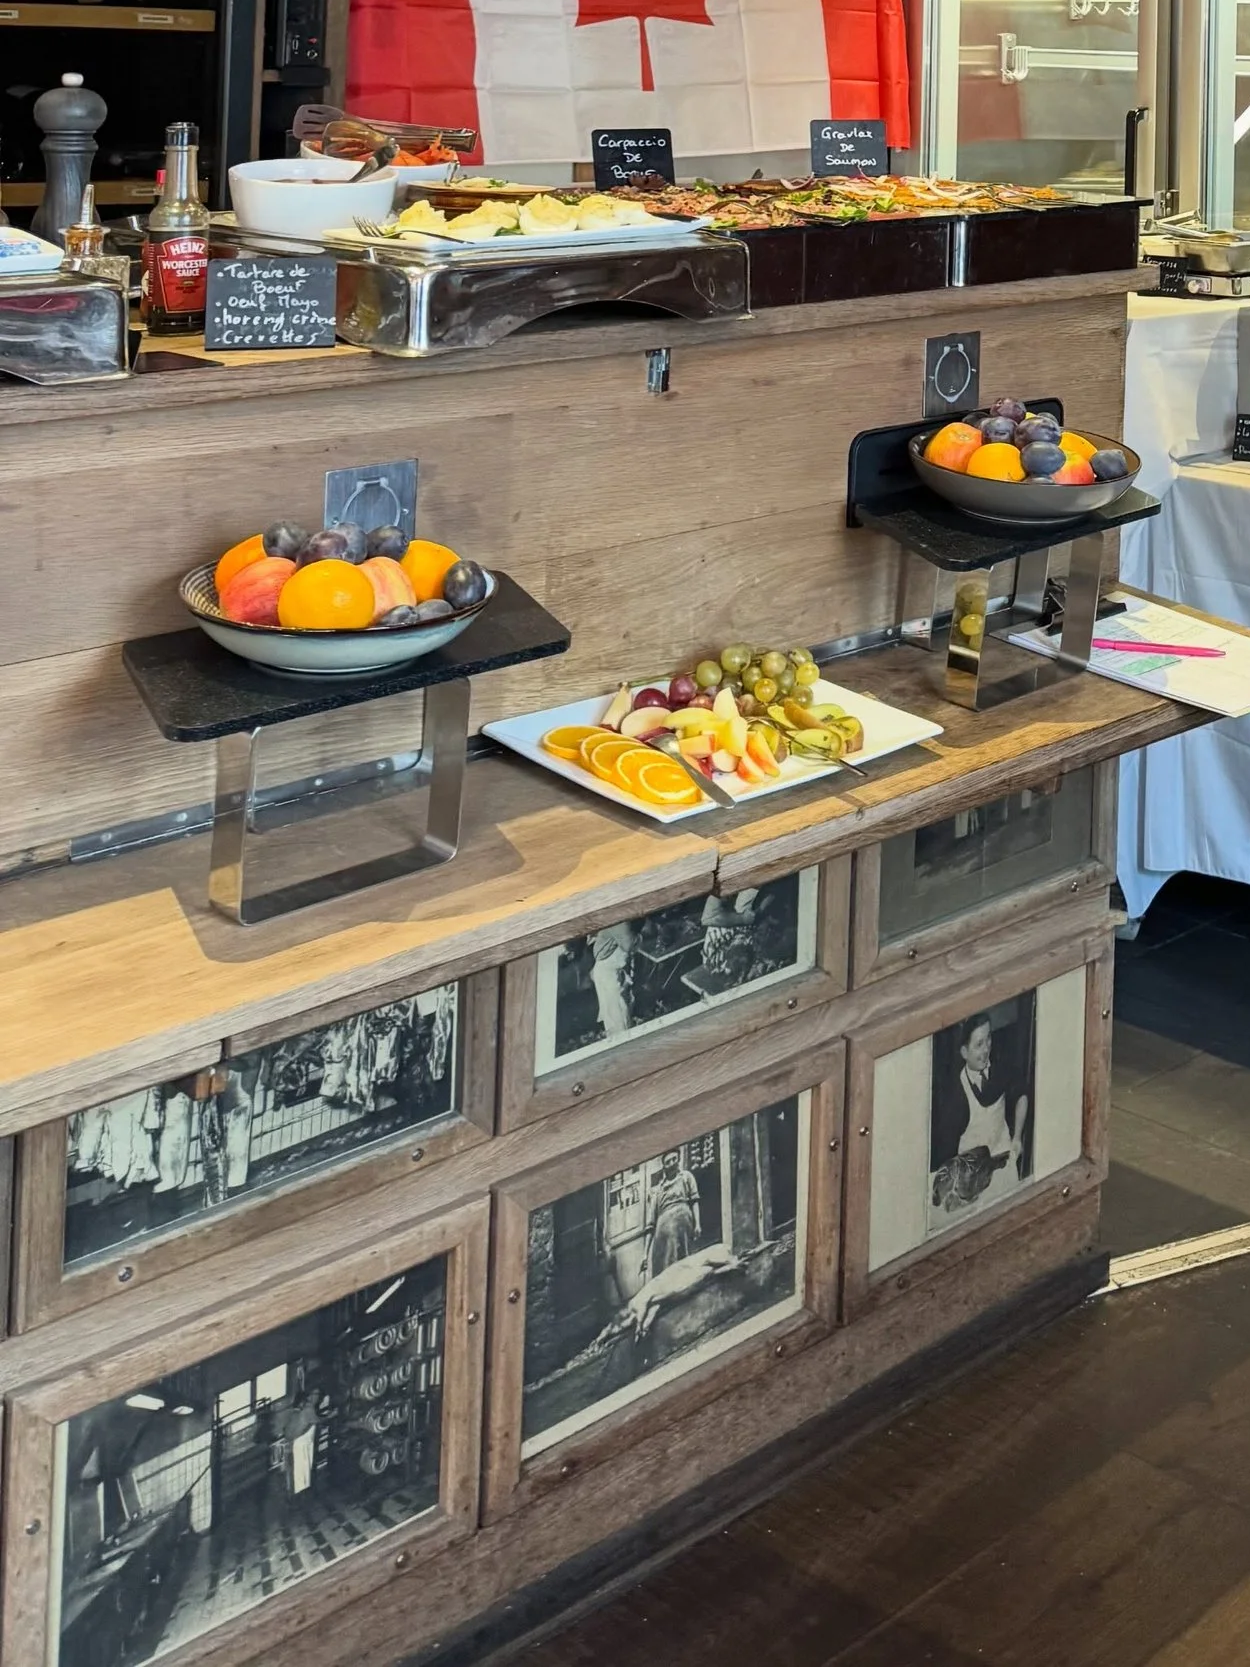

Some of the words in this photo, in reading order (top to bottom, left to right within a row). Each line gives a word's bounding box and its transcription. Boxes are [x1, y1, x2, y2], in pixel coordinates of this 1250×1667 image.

[821, 126, 873, 139] Gravlax
[598, 134, 666, 150] Carpaccio
[169, 241, 205, 255] HEINZ
[176, 269, 200, 277] SAUCE
[223, 263, 285, 278] Tartare
[289, 264, 311, 277] de
